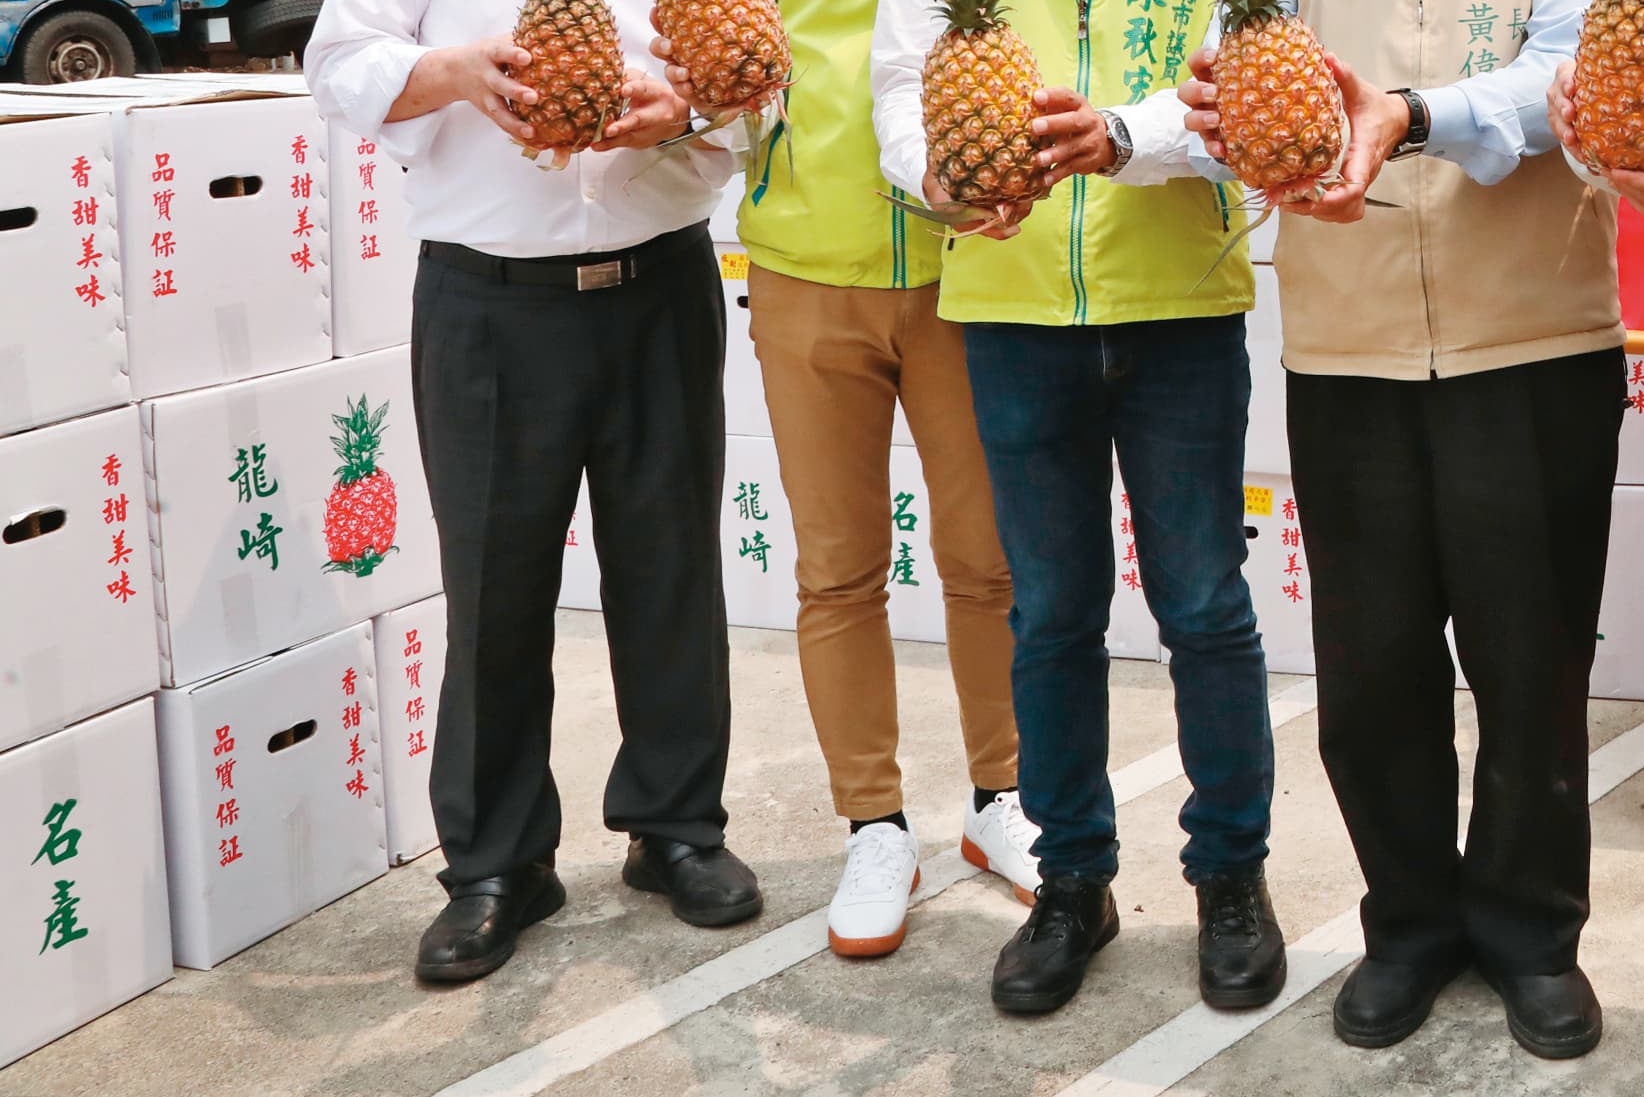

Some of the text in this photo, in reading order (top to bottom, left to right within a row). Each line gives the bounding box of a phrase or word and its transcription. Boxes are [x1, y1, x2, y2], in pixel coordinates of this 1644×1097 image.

[71, 155, 106, 308] 香甜美味
[151, 152, 178, 297] 品質保証
[290, 135, 315, 273] 香甜美味
[357, 137, 381, 260] 品質保証
[101, 454, 137, 604] 香甜美味
[228, 442, 283, 571] 龍崎
[733, 482, 771, 573] 龍崎
[890, 491, 919, 586] 名產
[1281, 498, 1303, 603] 香甜美味
[341, 667, 369, 799] 香甜美味
[403, 629, 428, 757] 品質保証
[213, 725, 243, 867] 品質保証
[32, 798, 89, 956] 名產
